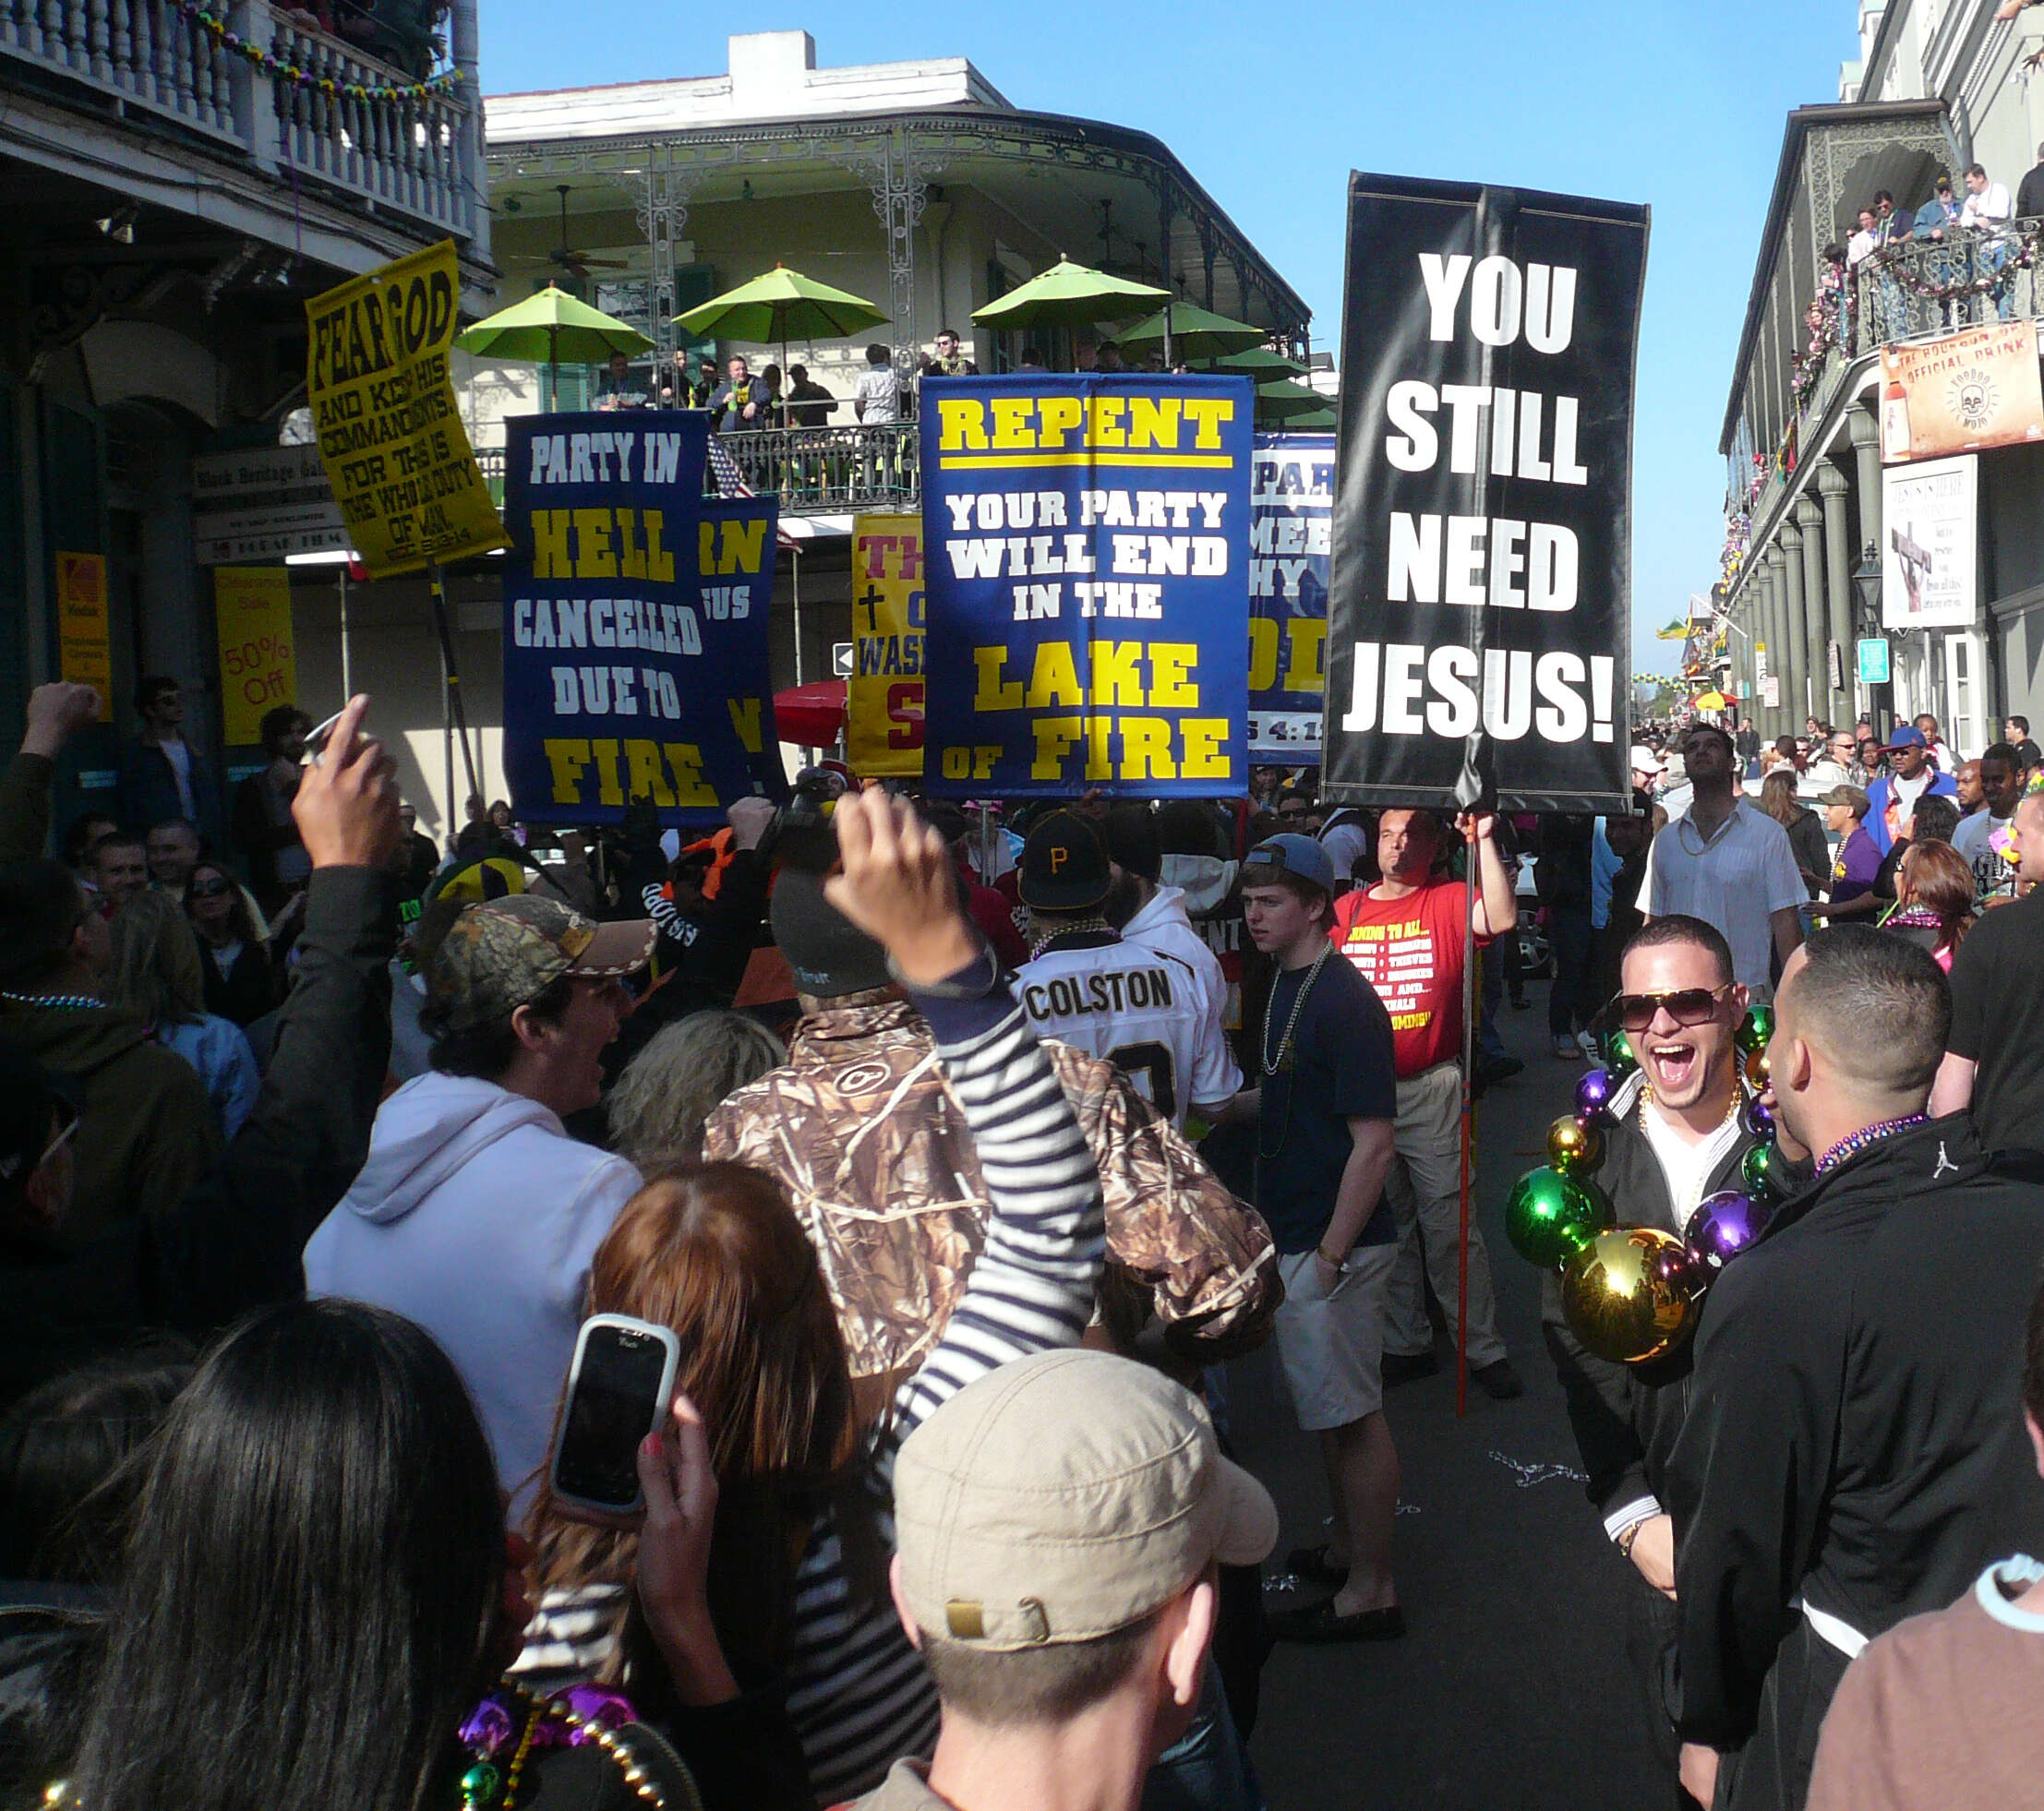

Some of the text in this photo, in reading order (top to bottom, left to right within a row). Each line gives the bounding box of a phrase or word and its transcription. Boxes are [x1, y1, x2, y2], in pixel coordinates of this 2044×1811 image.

[1418, 252, 1577, 354] YOU
[313, 292, 395, 392] FEAR
[1907, 338, 2025, 383] OFFICIAL DRINK
[319, 390, 363, 429] AND
[937, 397, 1234, 450] REPENT
[1385, 379, 1588, 486] STILL
[341, 454, 387, 492] FOR
[530, 431, 681, 484] PARTY IN
[342, 491, 378, 524] THE
[388, 513, 414, 546] OF
[945, 490, 1228, 531] YOUR PARTY
[531, 508, 676, 582] HELL
[945, 534, 1229, 580] WILL END
[1249, 517, 1332, 555] MEE
[1248, 558, 1308, 597] HY
[1387, 511, 1580, 612] NEED
[1013, 582, 1163, 621] IN THE
[513, 599, 703, 656] CANCELLED
[224, 634, 291, 677] 50%
[858, 634, 926, 678] WAS
[973, 640, 1199, 712] LAKE
[243, 667, 286, 705] Off
[551, 666, 681, 720] DUE TO
[1341, 642, 1614, 743] JESUS!
[544, 738, 720, 807] FIRE
[941, 715, 1231, 781] OF FIRE
[1050, 846, 1068, 874] P
[1024, 969, 1172, 1021] COLSTON
